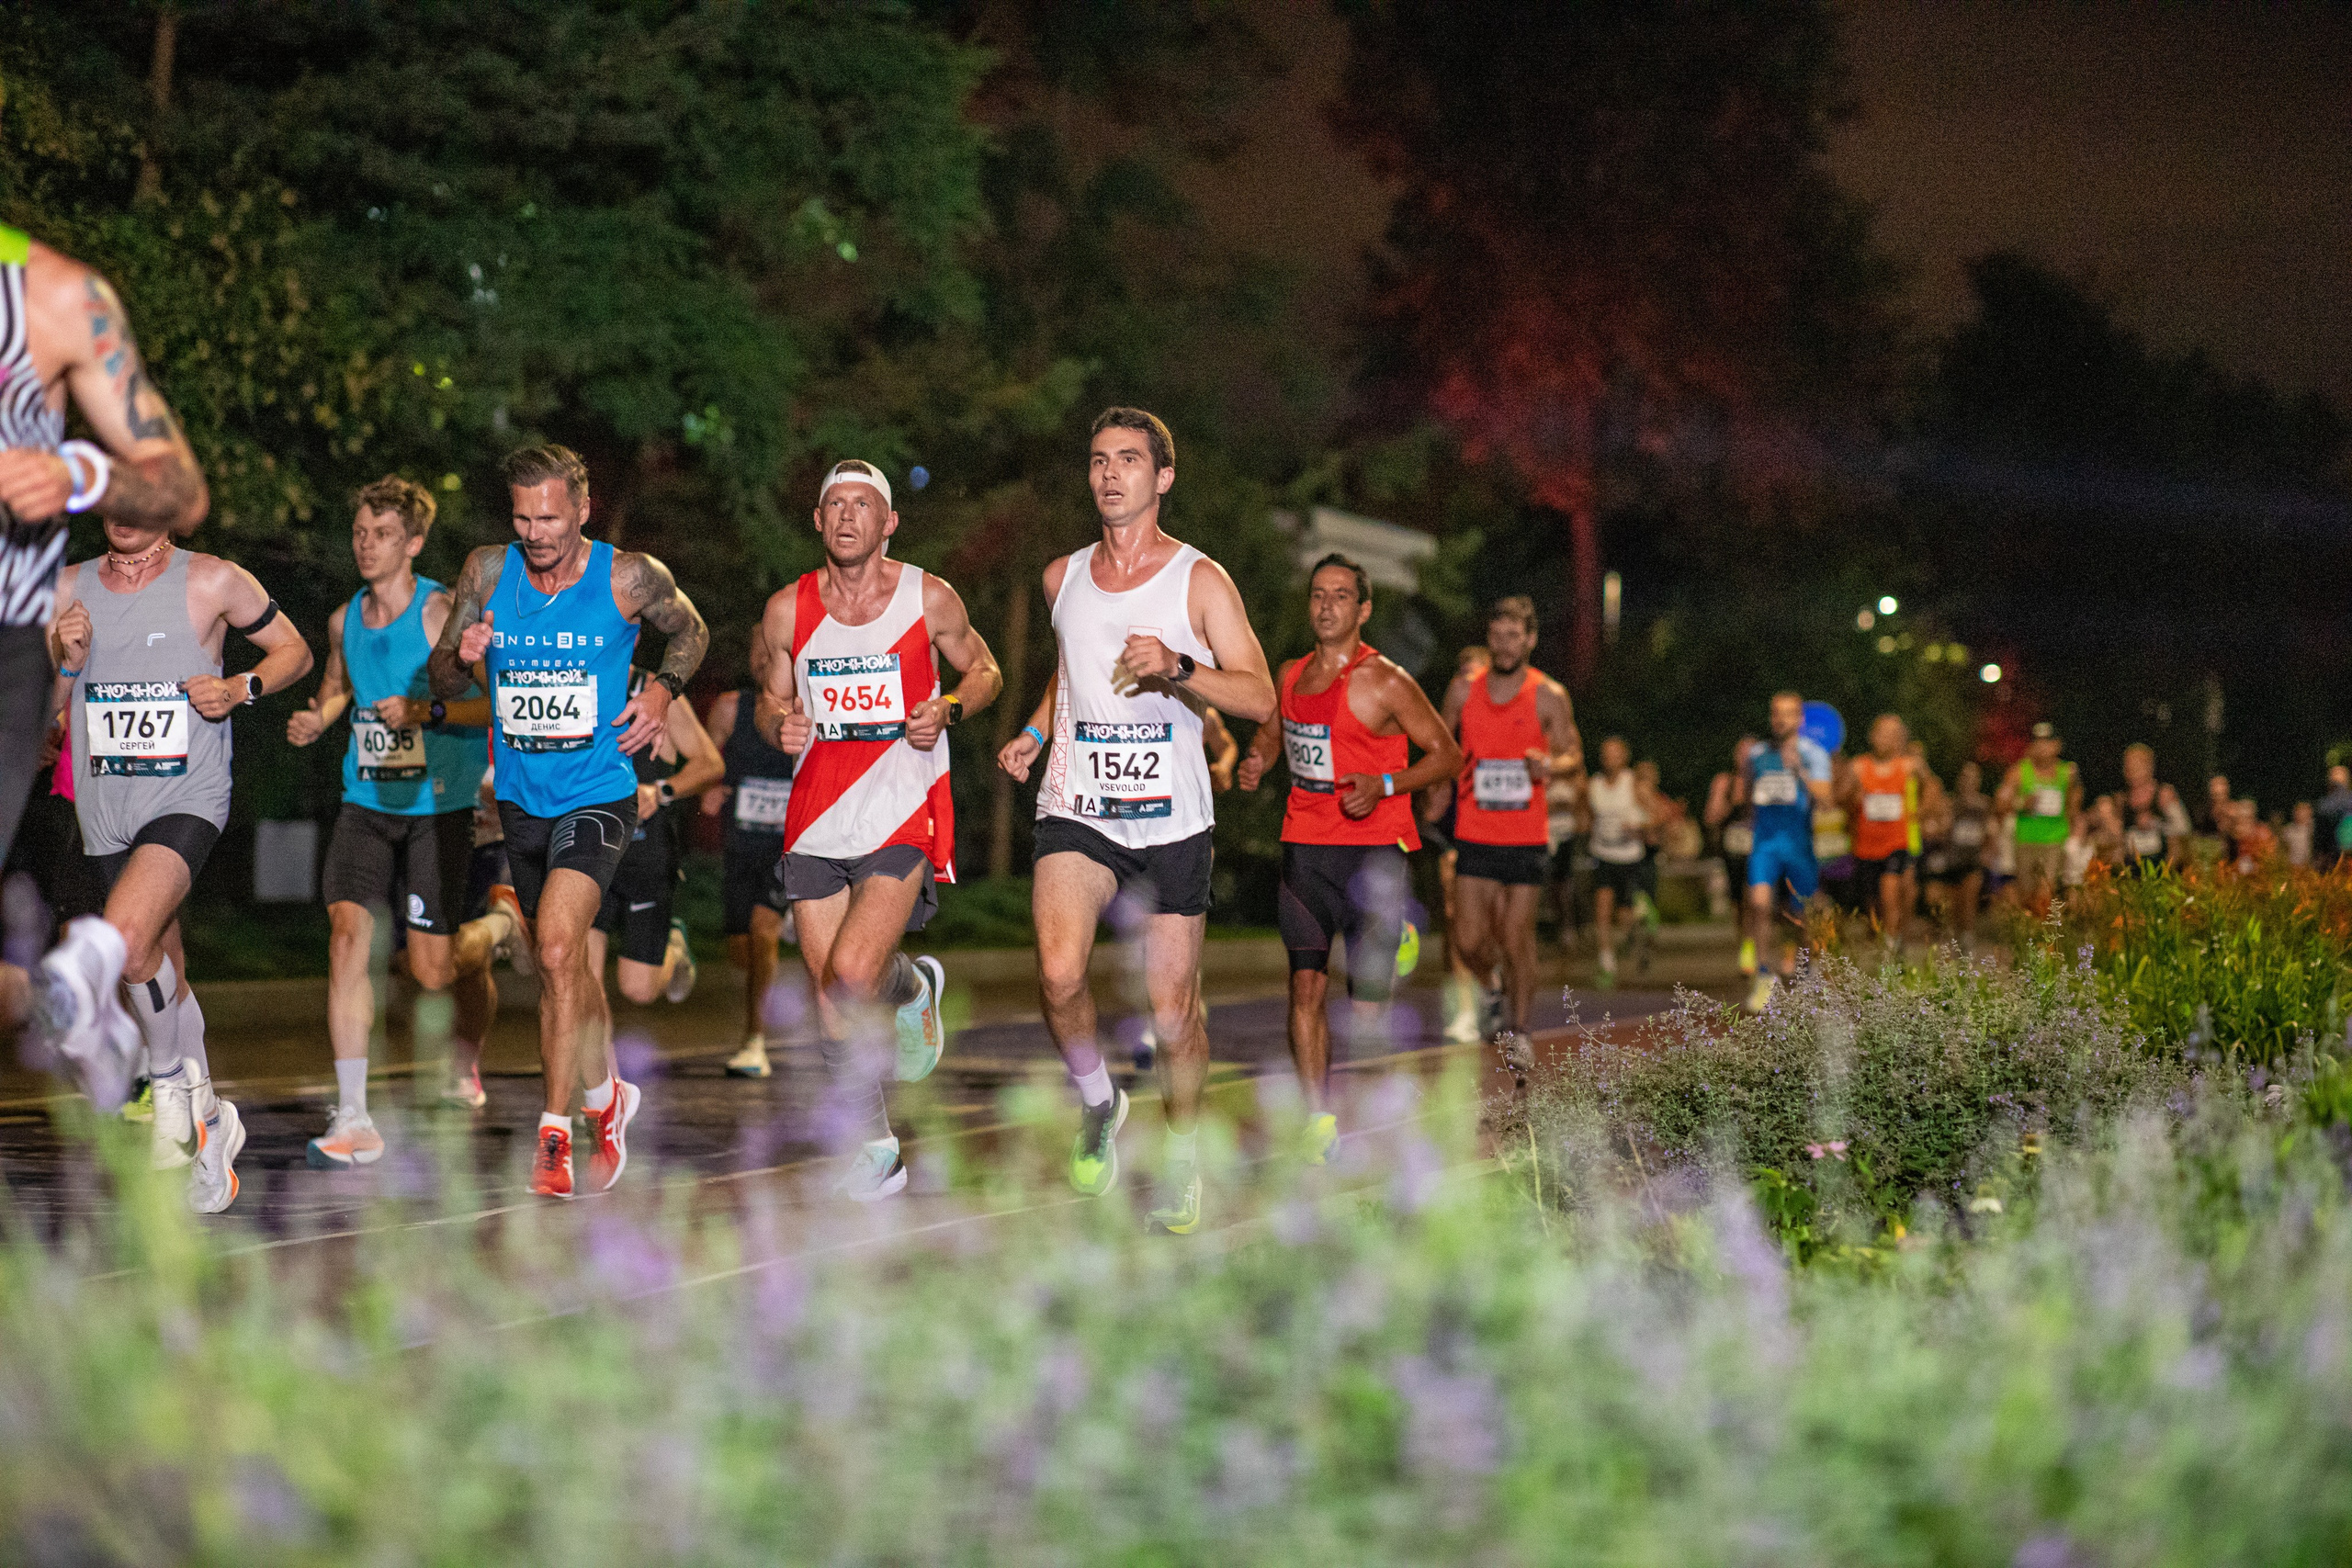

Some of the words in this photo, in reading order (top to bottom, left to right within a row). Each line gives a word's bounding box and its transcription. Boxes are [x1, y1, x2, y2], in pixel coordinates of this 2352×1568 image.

[508, 659, 586, 667] GYMWEAR
[823, 684, 892, 712] 9654
[511, 694, 581, 720] 2064
[103, 710, 175, 739] 1767
[530, 723, 561, 731] ДЕНИС
[829, 723, 840, 736] A
[119, 740, 155, 750] СЕРГЕЙ
[364, 729, 414, 751] 6035
[100, 759, 112, 774] A
[1089, 751, 1159, 781] 1542
[1099, 783, 1146, 792] VSEVOLOD
[1085, 797, 1097, 813] A
[921, 1007, 937, 1046] HOKA
